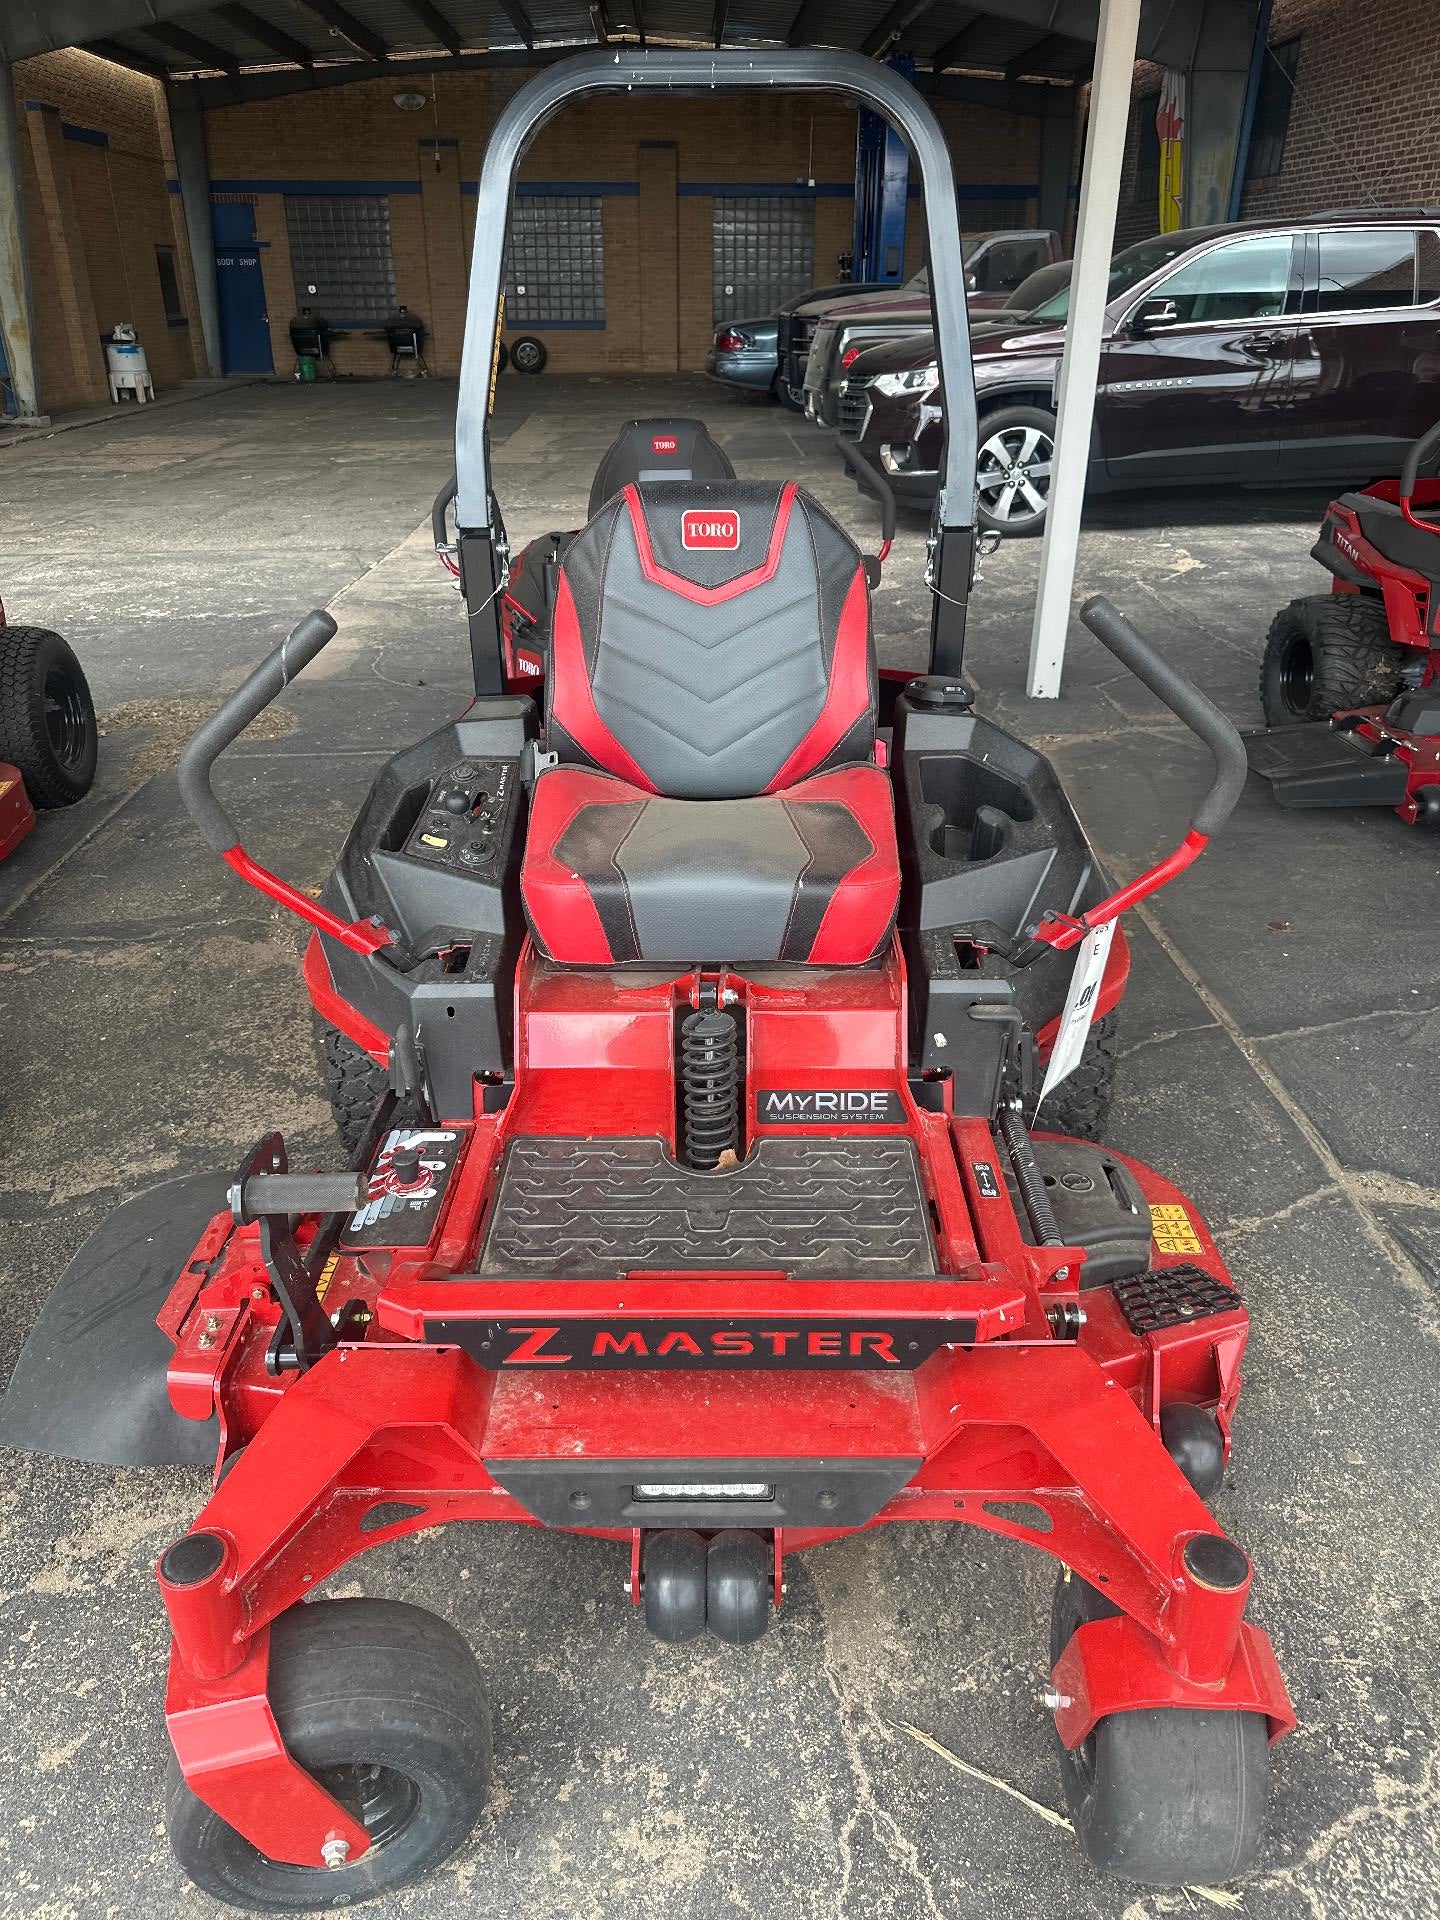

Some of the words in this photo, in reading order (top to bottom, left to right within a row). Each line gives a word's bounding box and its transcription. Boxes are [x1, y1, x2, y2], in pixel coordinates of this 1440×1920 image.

[216, 258, 234, 266] BODY
[239, 258, 257, 266] SHOP
[654, 441, 676, 450] TORO
[687, 523, 734, 537] TORO
[1337, 532, 1359, 561] TITAN
[519, 658, 540, 676] TORO
[499, 765, 509, 789] MASTER
[502, 1327, 574, 1364] Z
[592, 1331, 901, 1363] MASTER
